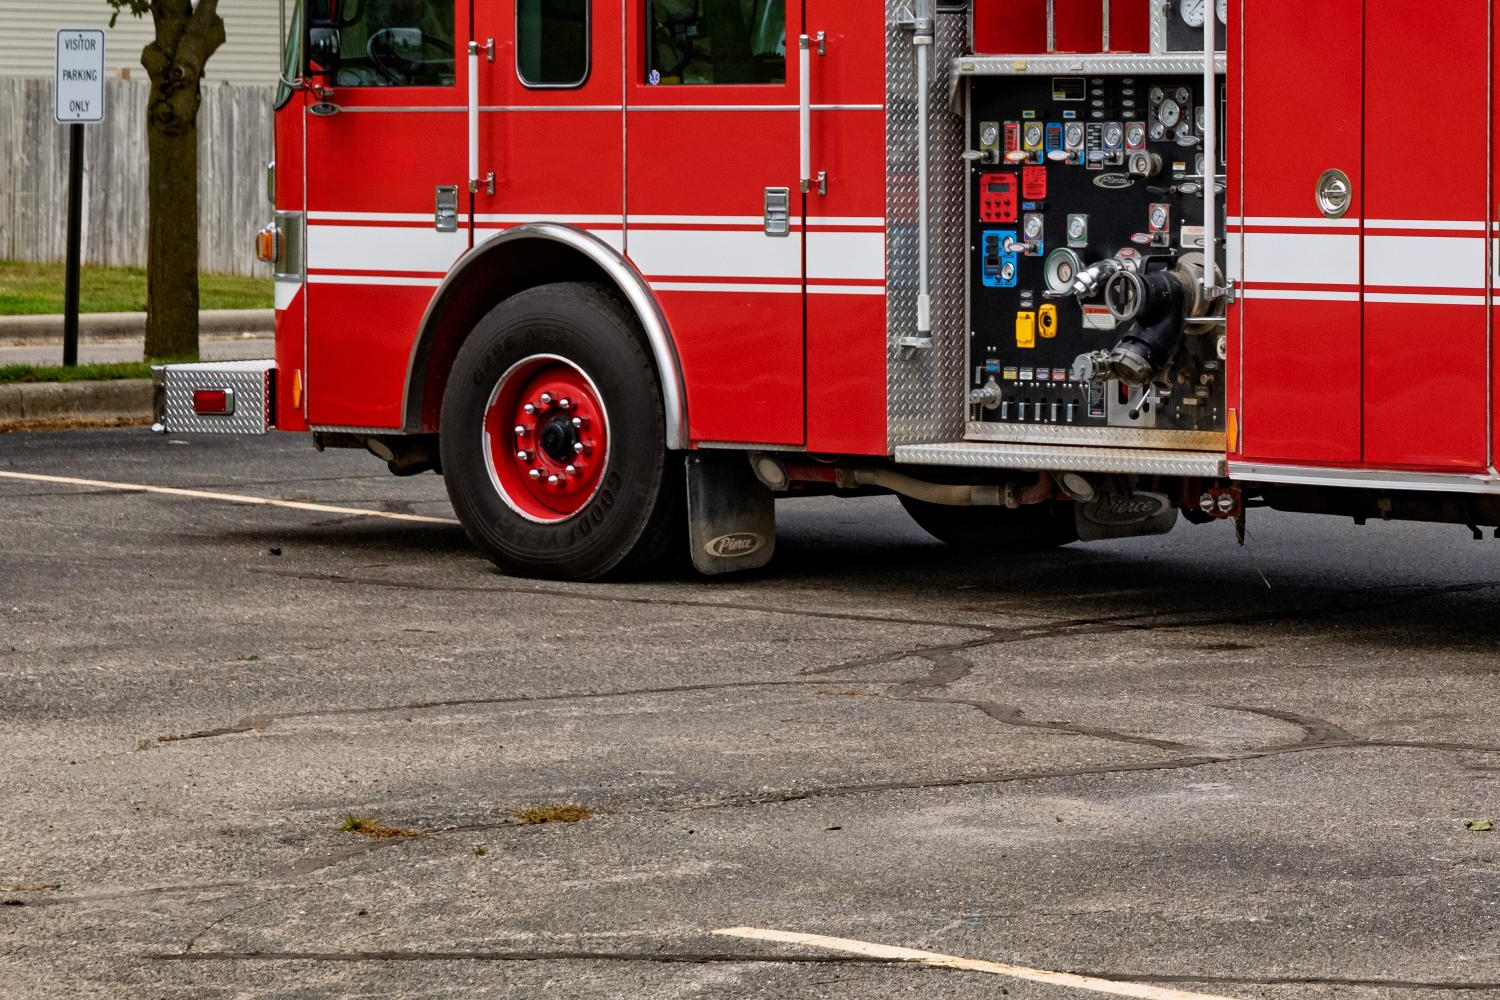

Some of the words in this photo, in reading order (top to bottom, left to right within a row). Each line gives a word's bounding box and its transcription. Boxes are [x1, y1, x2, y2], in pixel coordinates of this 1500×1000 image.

[65, 39, 96, 50] VISITOR
[63, 69, 97, 81] PARKING
[69, 100, 90, 112] ONLY
